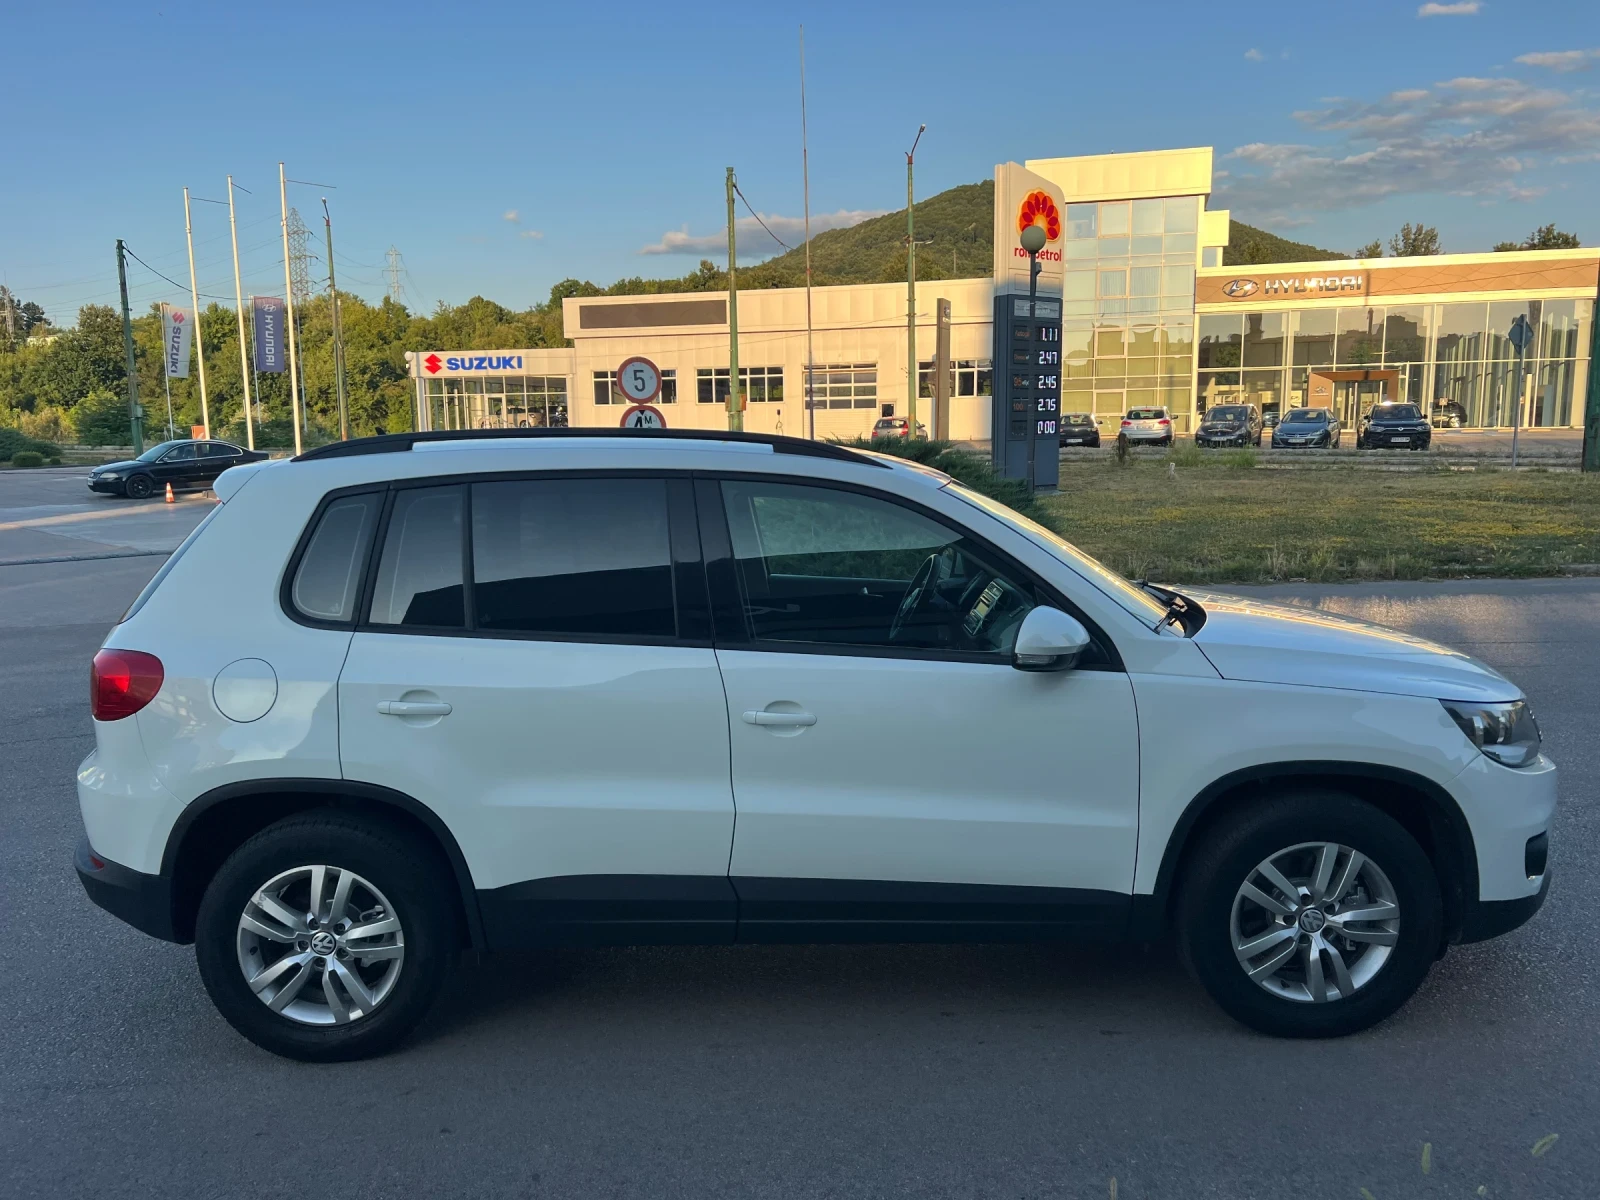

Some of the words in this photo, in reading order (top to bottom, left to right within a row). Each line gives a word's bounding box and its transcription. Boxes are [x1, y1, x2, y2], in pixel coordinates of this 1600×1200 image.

[1264, 275, 1362, 294] HYUNDAI
[264, 315, 275, 366] HYUNDAI
[170, 326, 182, 373] SUZUKI
[446, 356, 522, 370] SUZUKI
[1038, 351, 1058, 365] 2.47
[633, 369, 646, 392] 5
[1038, 375, 1057, 389] 2.45
[1037, 398, 1056, 411] 2.75
